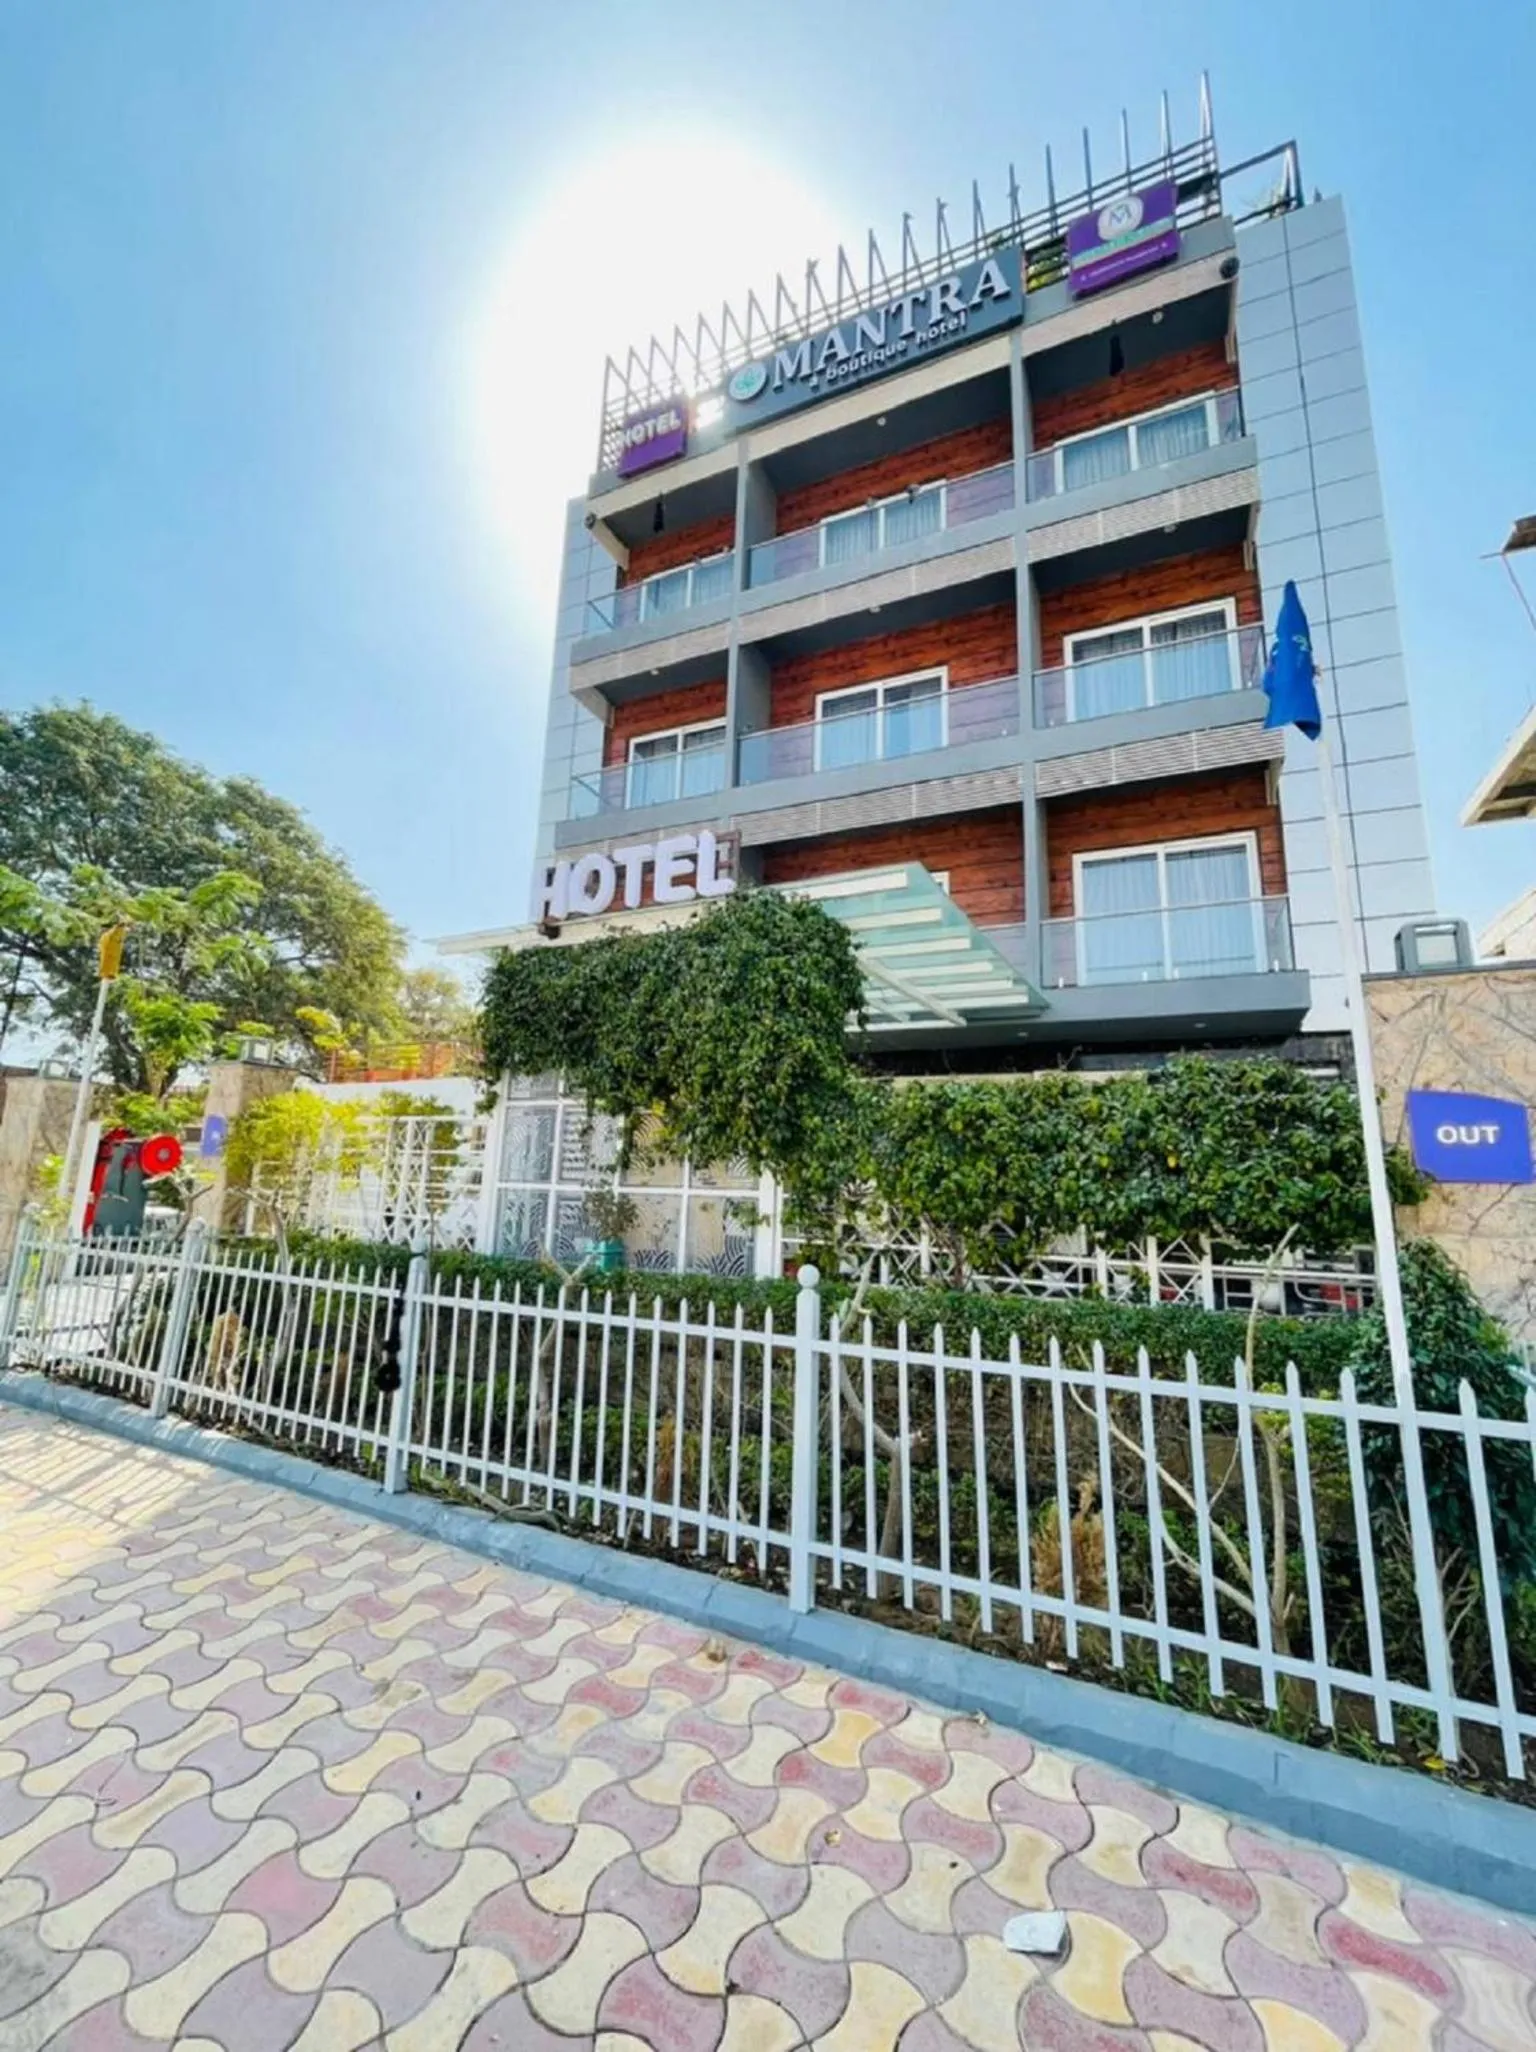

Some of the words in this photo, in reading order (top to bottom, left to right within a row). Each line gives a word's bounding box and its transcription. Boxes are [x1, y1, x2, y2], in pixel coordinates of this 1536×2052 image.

[772, 259, 1010, 388] MANTRA
[826, 340, 907, 380] boutique
[915, 311, 966, 344] hotel
[616, 409, 681, 457] HOTEL
[532, 829, 736, 924] HOTEL
[1437, 1125, 1499, 1145] OUT
